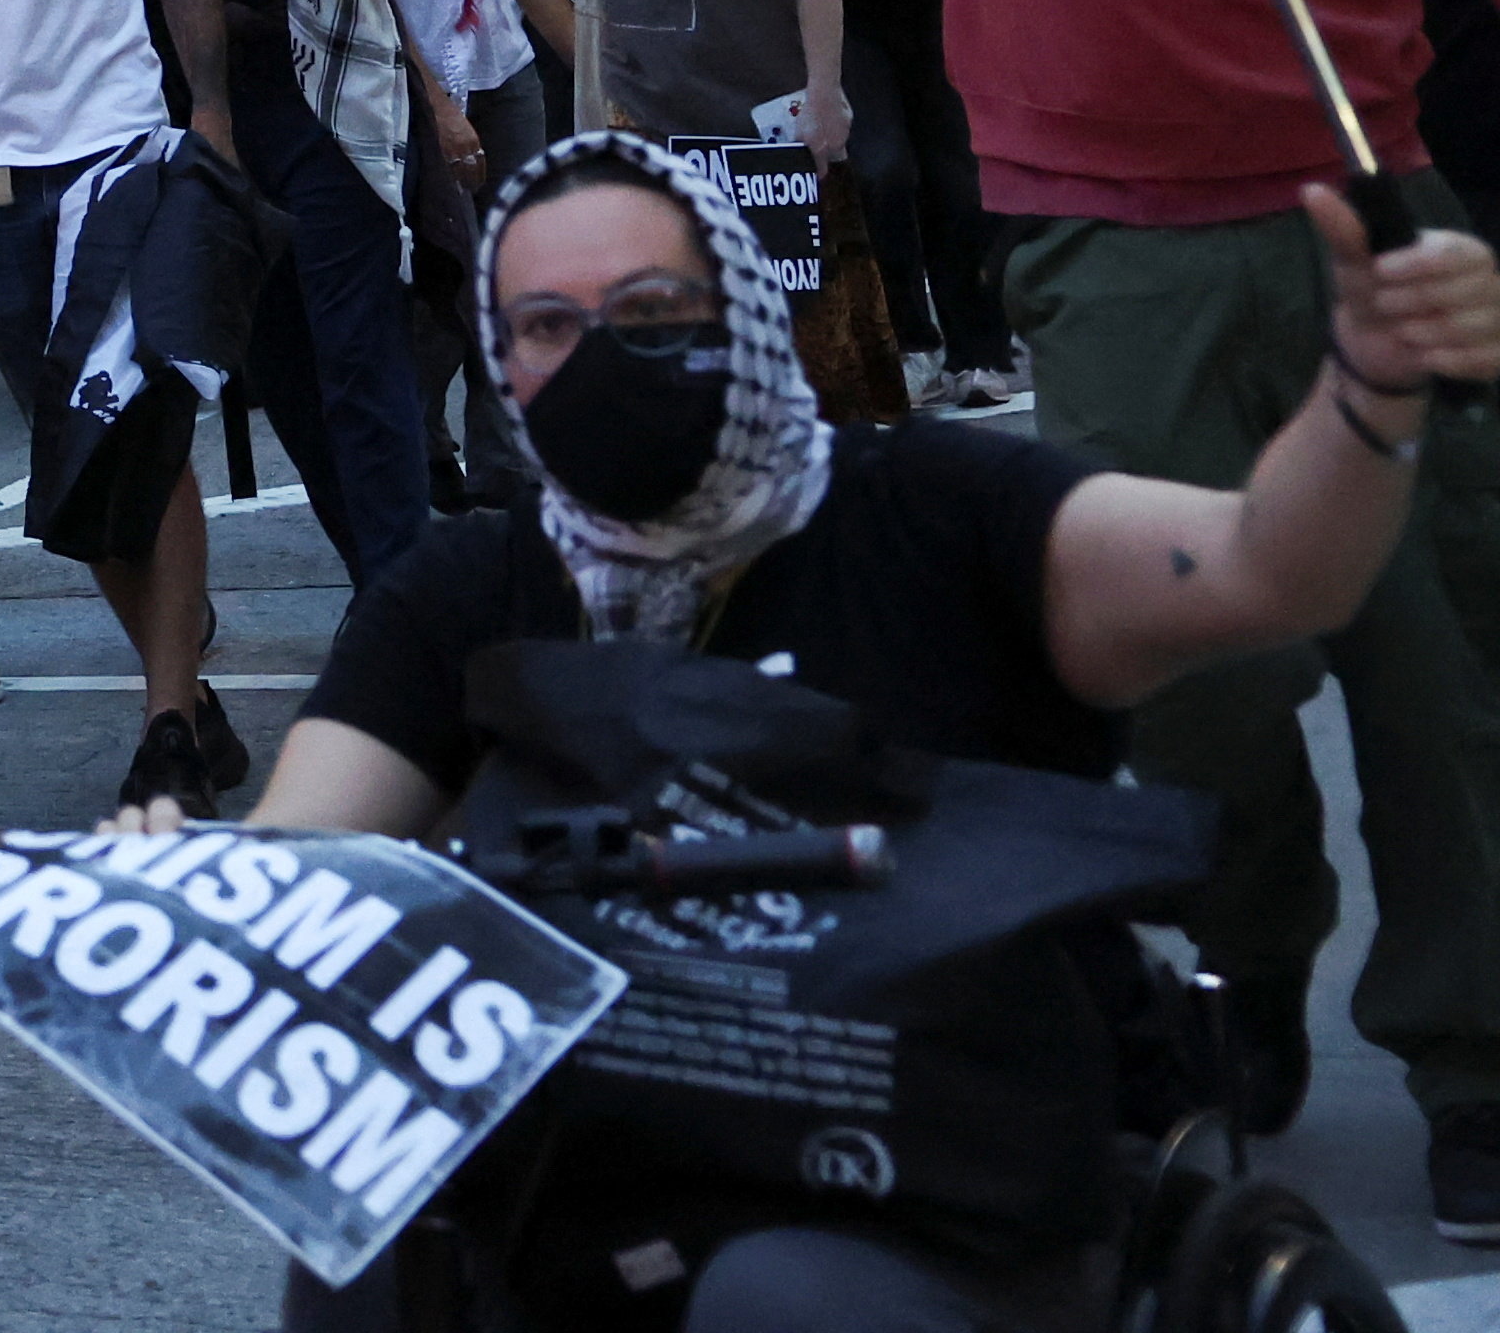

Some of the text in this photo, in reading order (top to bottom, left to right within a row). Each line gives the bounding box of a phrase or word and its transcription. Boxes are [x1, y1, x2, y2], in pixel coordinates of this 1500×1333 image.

[734, 172, 819, 208] NOCIDE
[770, 258, 820, 291] RYON
[4, 831, 402, 991] NISM
[368, 945, 534, 1089] IS
